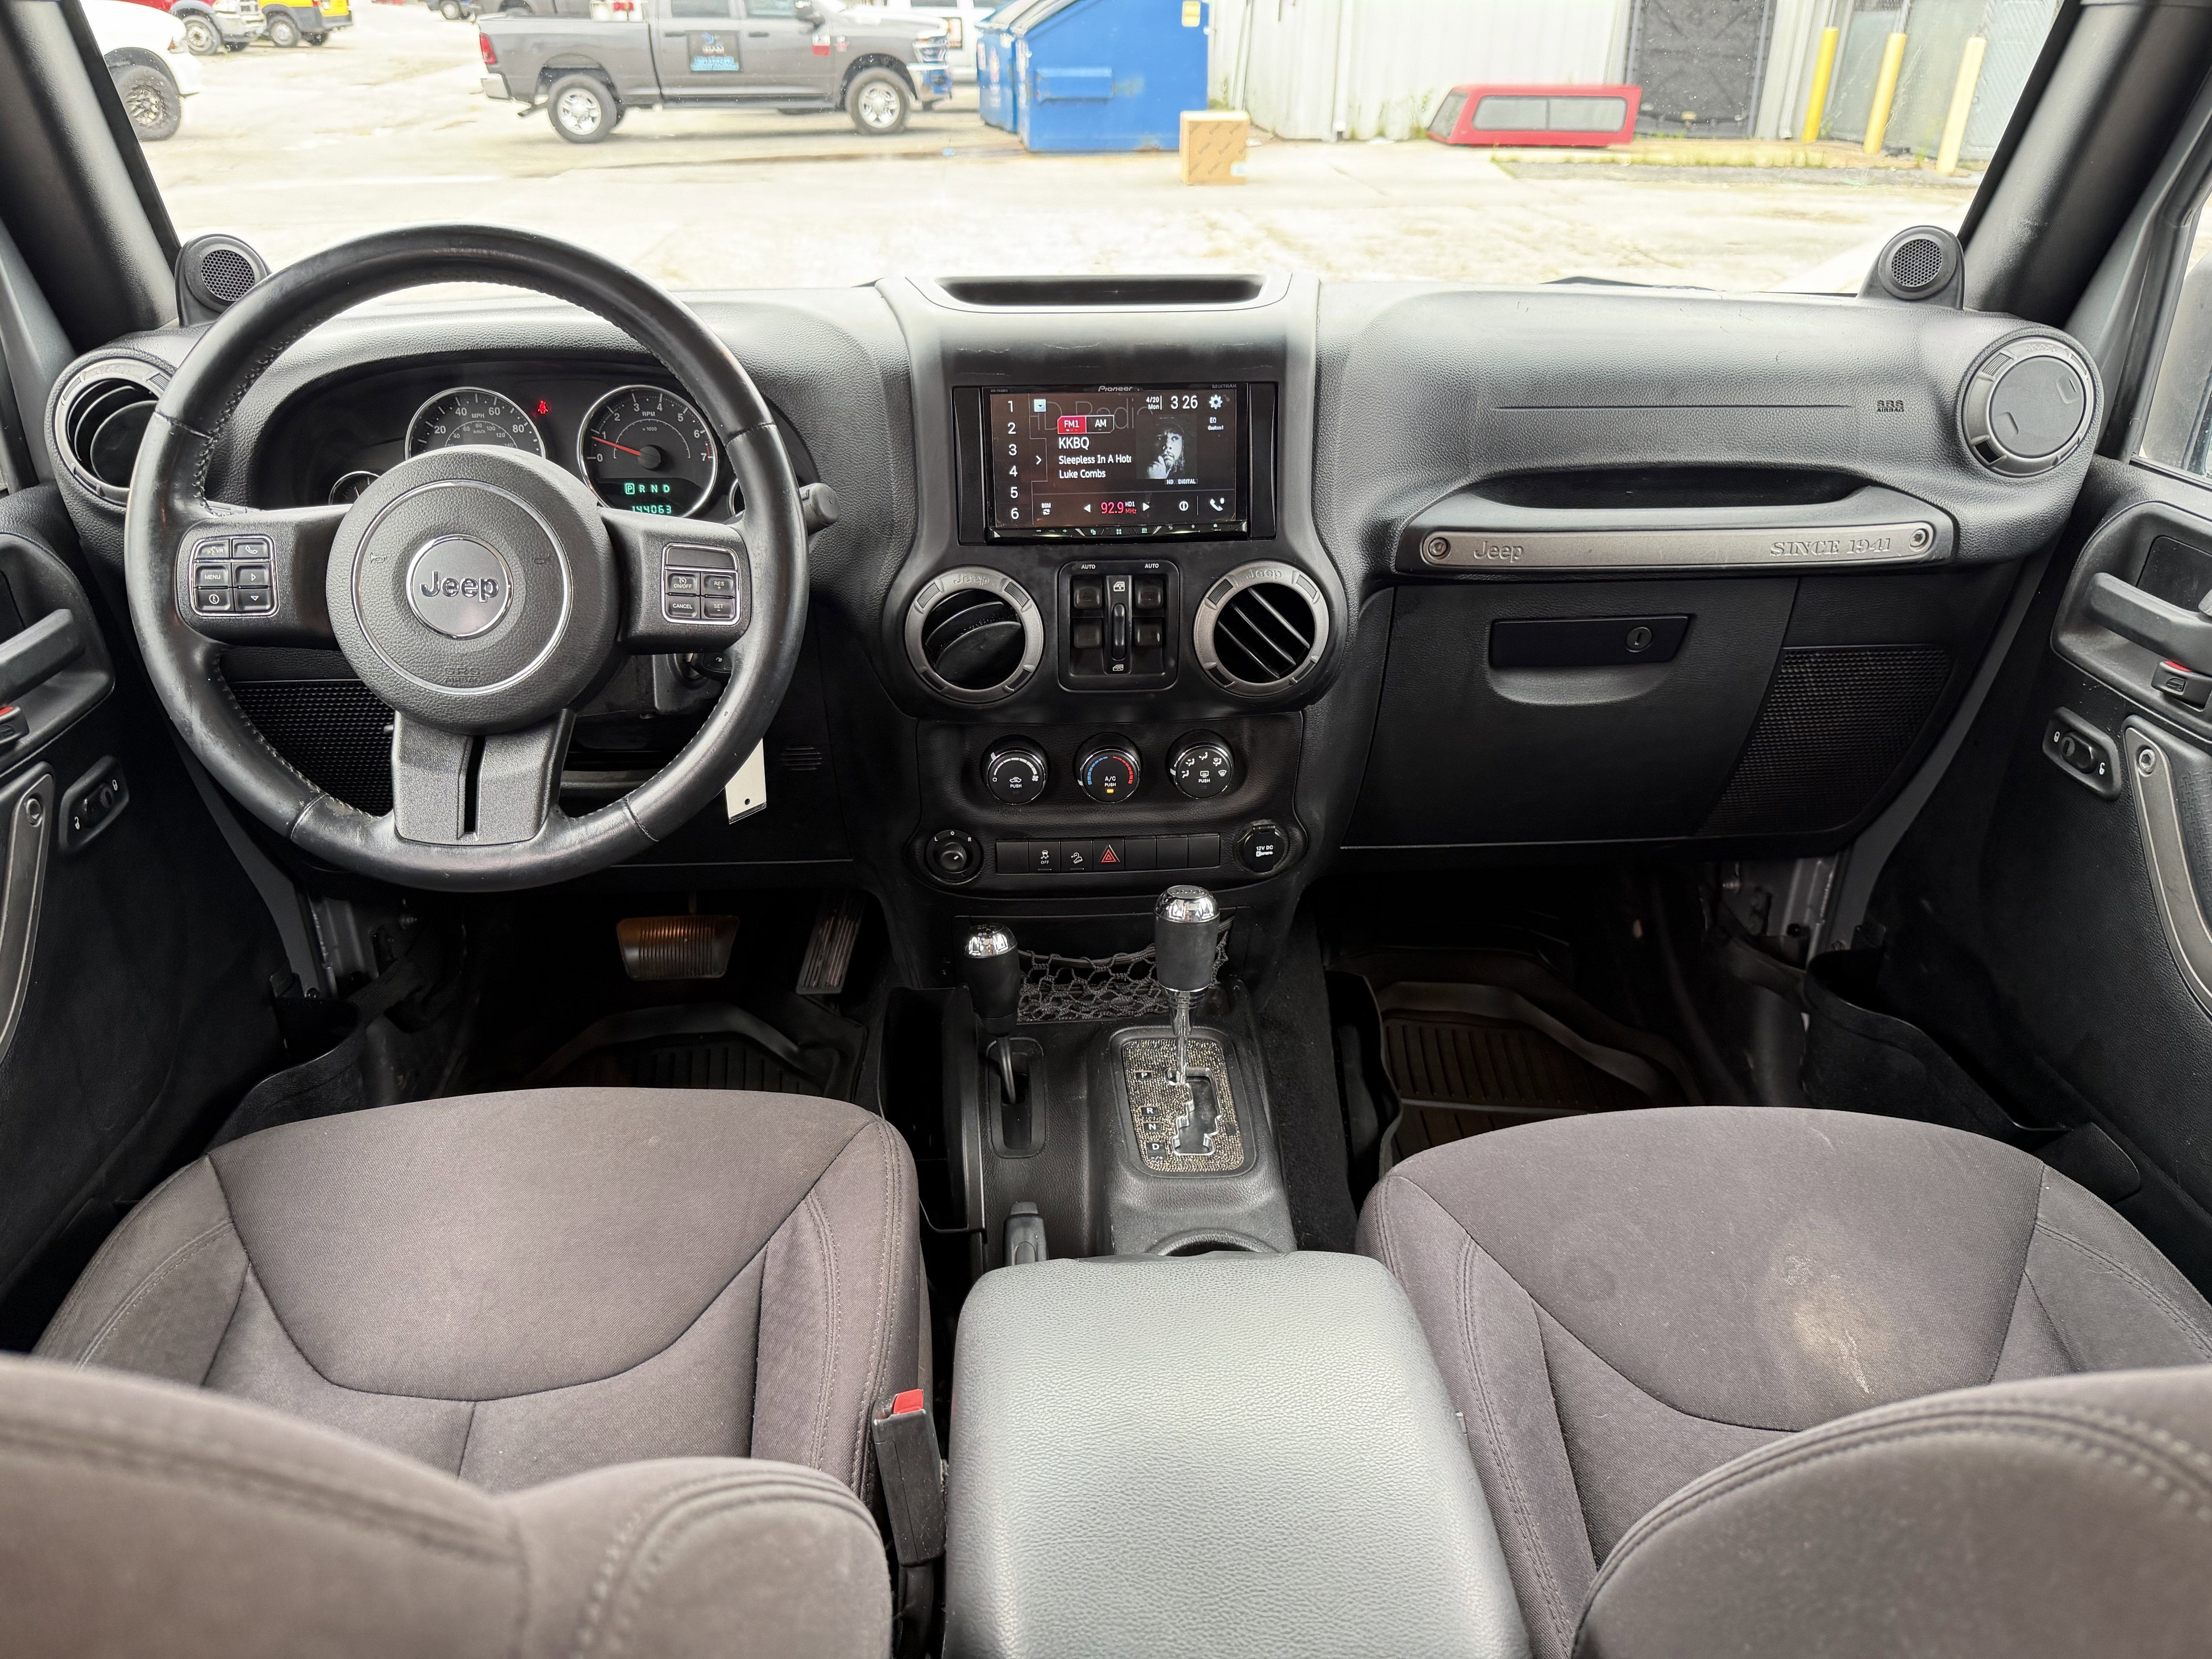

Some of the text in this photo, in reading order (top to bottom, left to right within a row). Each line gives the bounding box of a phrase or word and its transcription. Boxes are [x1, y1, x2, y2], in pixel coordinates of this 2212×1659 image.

[634, 403, 640, 412] 3
[656, 403, 663, 411] 4
[1008, 400, 1013, 413] 1
[455, 407, 467, 416] 40
[489, 407, 501, 416] 60
[614, 413, 620, 421] 2
[678, 413, 684, 422] 5
[1008, 422, 1016, 434] 2
[1064, 420, 1079, 428] FM1
[1095, 419, 1107, 428] AM
[434, 426, 446, 434] 20
[512, 424, 524, 433] 80
[602, 431, 606, 439] 1
[694, 430, 700, 438] 6
[1059, 437, 1090, 450] KKBQ
[1009, 444, 1017, 456] 3
[597, 453, 603, 462] 0
[701, 453, 707, 461] 7
[1059, 455, 1095, 465] Sleepless
[1097, 454, 1106, 464] In
[1108, 454, 1114, 463] A
[1009, 465, 1018, 477] 4
[1059, 469, 1106, 479] Luke Combs
[639, 484, 646, 493] R
[651, 484, 658, 493] N
[663, 484, 670, 493] D
[1010, 487, 1018, 498] 5
[1101, 501, 1124, 514] 92.9
[1011, 508, 1019, 520] 6
[1474, 541, 1524, 563] Jeep
[1770, 538, 1891, 557] SINCE 1941
[419, 570, 500, 603] Jeep
